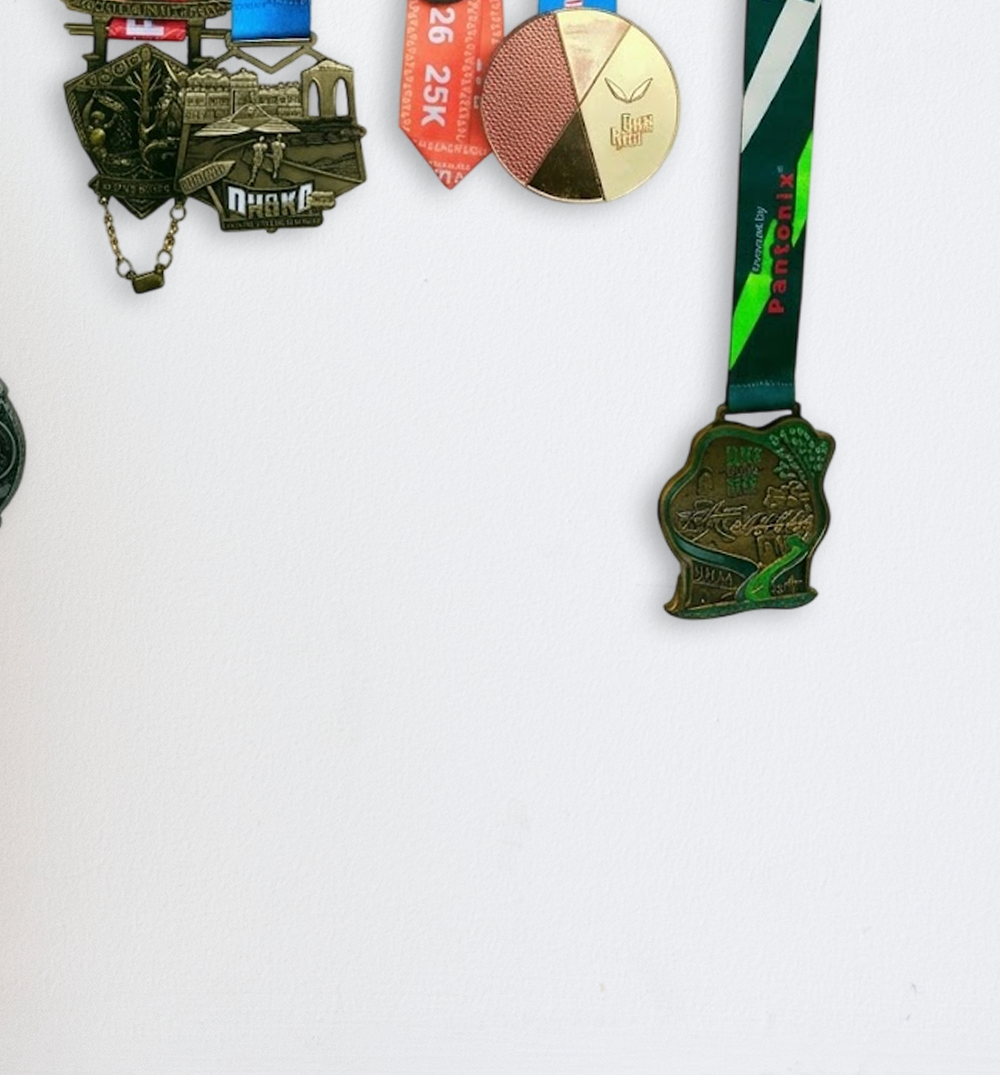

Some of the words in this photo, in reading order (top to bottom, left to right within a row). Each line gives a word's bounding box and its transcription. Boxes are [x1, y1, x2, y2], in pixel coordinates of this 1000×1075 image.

[428, 7, 456, 45] 26
[421, 64, 451, 127] 25K
[768, 173, 795, 314] Pantonix
